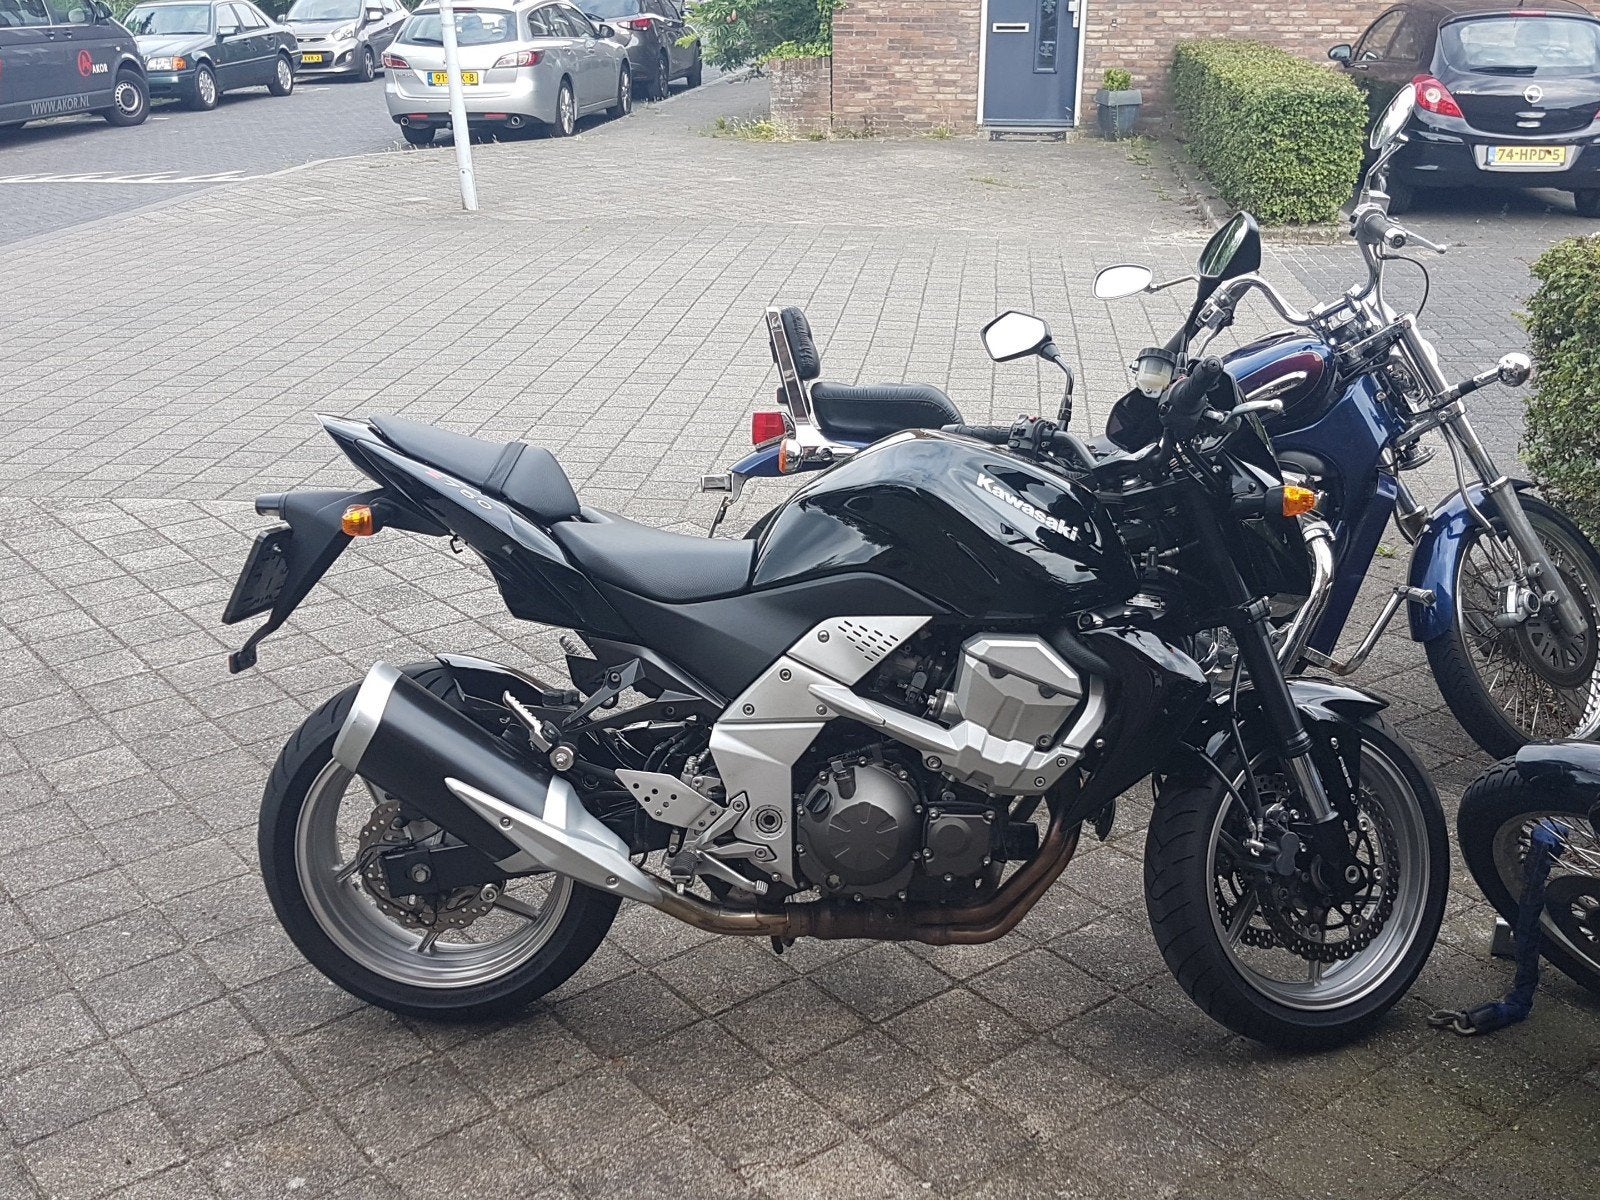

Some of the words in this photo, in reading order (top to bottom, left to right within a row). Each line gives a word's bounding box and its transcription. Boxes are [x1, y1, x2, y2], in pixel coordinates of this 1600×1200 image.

[92, 63, 108, 74] AKOR
[31, 95, 90, 115] WWW.AKOR.NL
[976, 472, 1079, 542] Kawasaki
